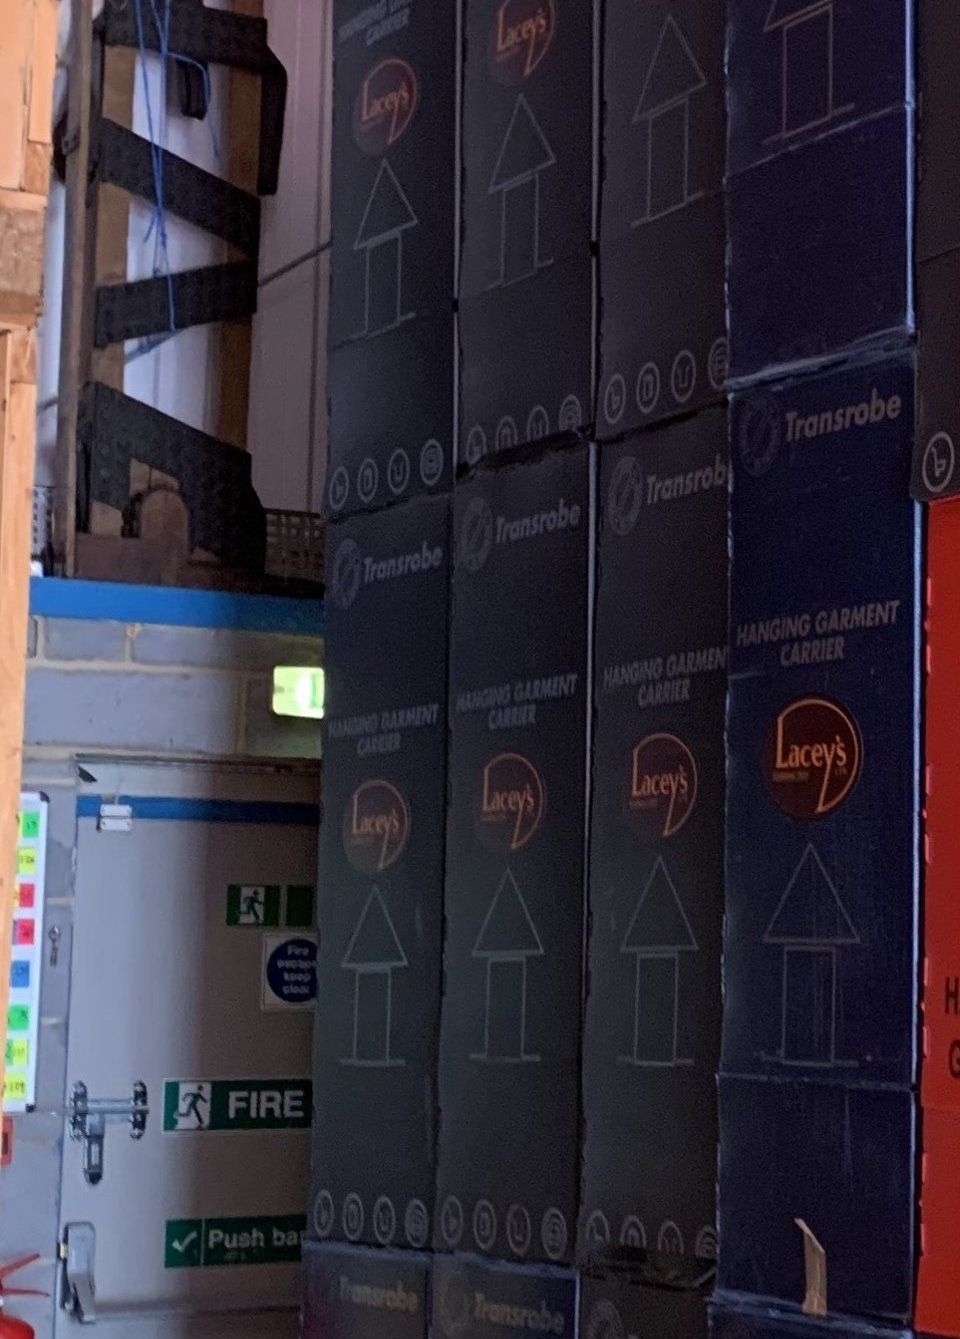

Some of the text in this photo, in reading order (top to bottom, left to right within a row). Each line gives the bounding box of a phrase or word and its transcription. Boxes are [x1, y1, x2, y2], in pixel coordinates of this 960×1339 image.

[785, 387, 901, 443] Transrobe
[496, 498, 581, 544] Transrobe
[737, 600, 900, 646] HANGING GARMENT
[781, 635, 845, 667] CARRIER
[228, 1090, 304, 1119] FIRE
[208, 1227, 265, 1249] Push
